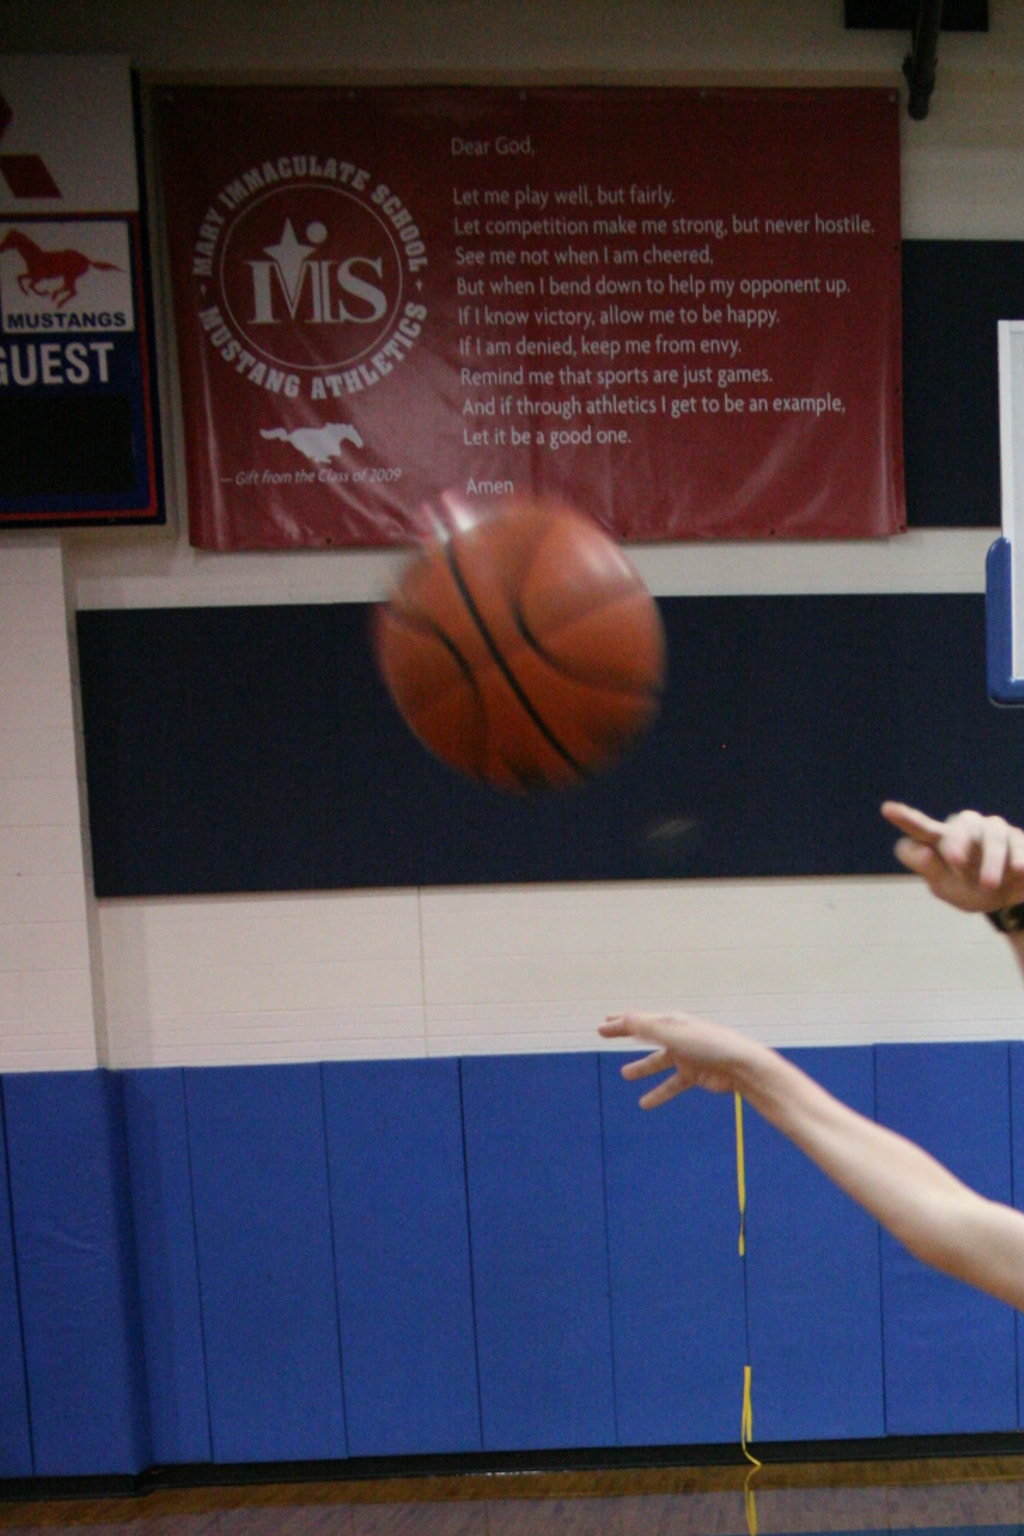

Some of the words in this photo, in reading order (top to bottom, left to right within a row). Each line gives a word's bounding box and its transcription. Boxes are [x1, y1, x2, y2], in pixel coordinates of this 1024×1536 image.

[451, 138, 489, 156] Dear
[495, 136, 535, 157] God,
[453, 187, 478, 204] Let
[484, 190, 510, 204] me
[515, 185, 548, 208] play
[555, 186, 592, 206] well,
[598, 184, 625, 204] but
[630, 185, 675, 208] fairly.
[193, 208, 228, 277] MARY
[219, 155, 371, 212] IMMACULATE
[370, 181, 430, 272] SCHOOL
[454, 217, 480, 235] Let
[486, 216, 589, 239] competition
[593, 215, 636, 234] make
[642, 220, 667, 233] me
[672, 217, 727, 239] strong,
[733, 214, 759, 233] but
[765, 218, 810, 232] never
[815, 214, 874, 233] hostile.
[456, 248, 484, 264] See
[490, 250, 515, 264] me
[521, 249, 548, 263] not
[554, 247, 599, 264] when
[603, 247, 609, 263] I
[613, 250, 638, 263] am
[643, 245, 713, 265] cheered,
[457, 278, 484, 295] But
[490, 277, 534, 294] when
[540, 277, 546, 294] I
[550, 276, 590, 294] bend
[596, 276, 641, 294] down
[647, 278, 664, 294] to
[669, 275, 705, 297] help
[711, 280, 734, 297] my
[740, 277, 820, 297] opponent
[826, 280, 850, 297] up.
[8, 312, 126, 328] MUSTANGS
[459, 308, 470, 325] If
[475, 307, 480, 325] I
[485, 307, 528, 325] know
[535, 308, 595, 330] victory,
[600, 305, 644, 324] allow
[650, 309, 674, 323] me
[680, 308, 697, 323] to
[703, 305, 723, 323] be
[727, 305, 779, 327] happy.
[198, 305, 301, 398] MUSTANG
[311, 299, 429, 400] ATHLETICS
[460, 338, 472, 355] If
[476, 338, 482, 355] I
[487, 342, 511, 355] am
[516, 336, 577, 357] denied,
[582, 336, 620, 358] keep
[626, 340, 650, 354] me
[656, 334, 695, 354] from
[701, 340, 741, 358] envy.
[461, 367, 523, 386] Remind
[530, 371, 554, 385] me
[559, 368, 592, 384] that
[597, 368, 648, 388] sports
[654, 370, 678, 384] are
[683, 366, 712, 387] just
[717, 369, 772, 388] games.
[463, 397, 495, 416] And
[500, 397, 512, 415] if
[517, 397, 581, 419] through
[587, 396, 655, 414] athletics
[661, 396, 666, 413] I
[671, 399, 697, 417] get
[702, 397, 719, 413] to
[725, 395, 744, 413] be
[749, 399, 768, 412] an
[773, 394, 845, 415] example,
[464, 428, 489, 445] Let
[495, 428, 505, 444] it
[511, 426, 531, 444] be
[536, 431, 545, 444] a
[550, 426, 591, 449] good
[597, 429, 631, 444] one.
[236, 471, 259, 485] Gift
[262, 470, 292, 484] from
[295, 469, 314, 483] the
[318, 468, 349, 482] Class
[352, 467, 365, 482] of
[369, 468, 402, 482] 2009
[466, 478, 513, 495] Amen
